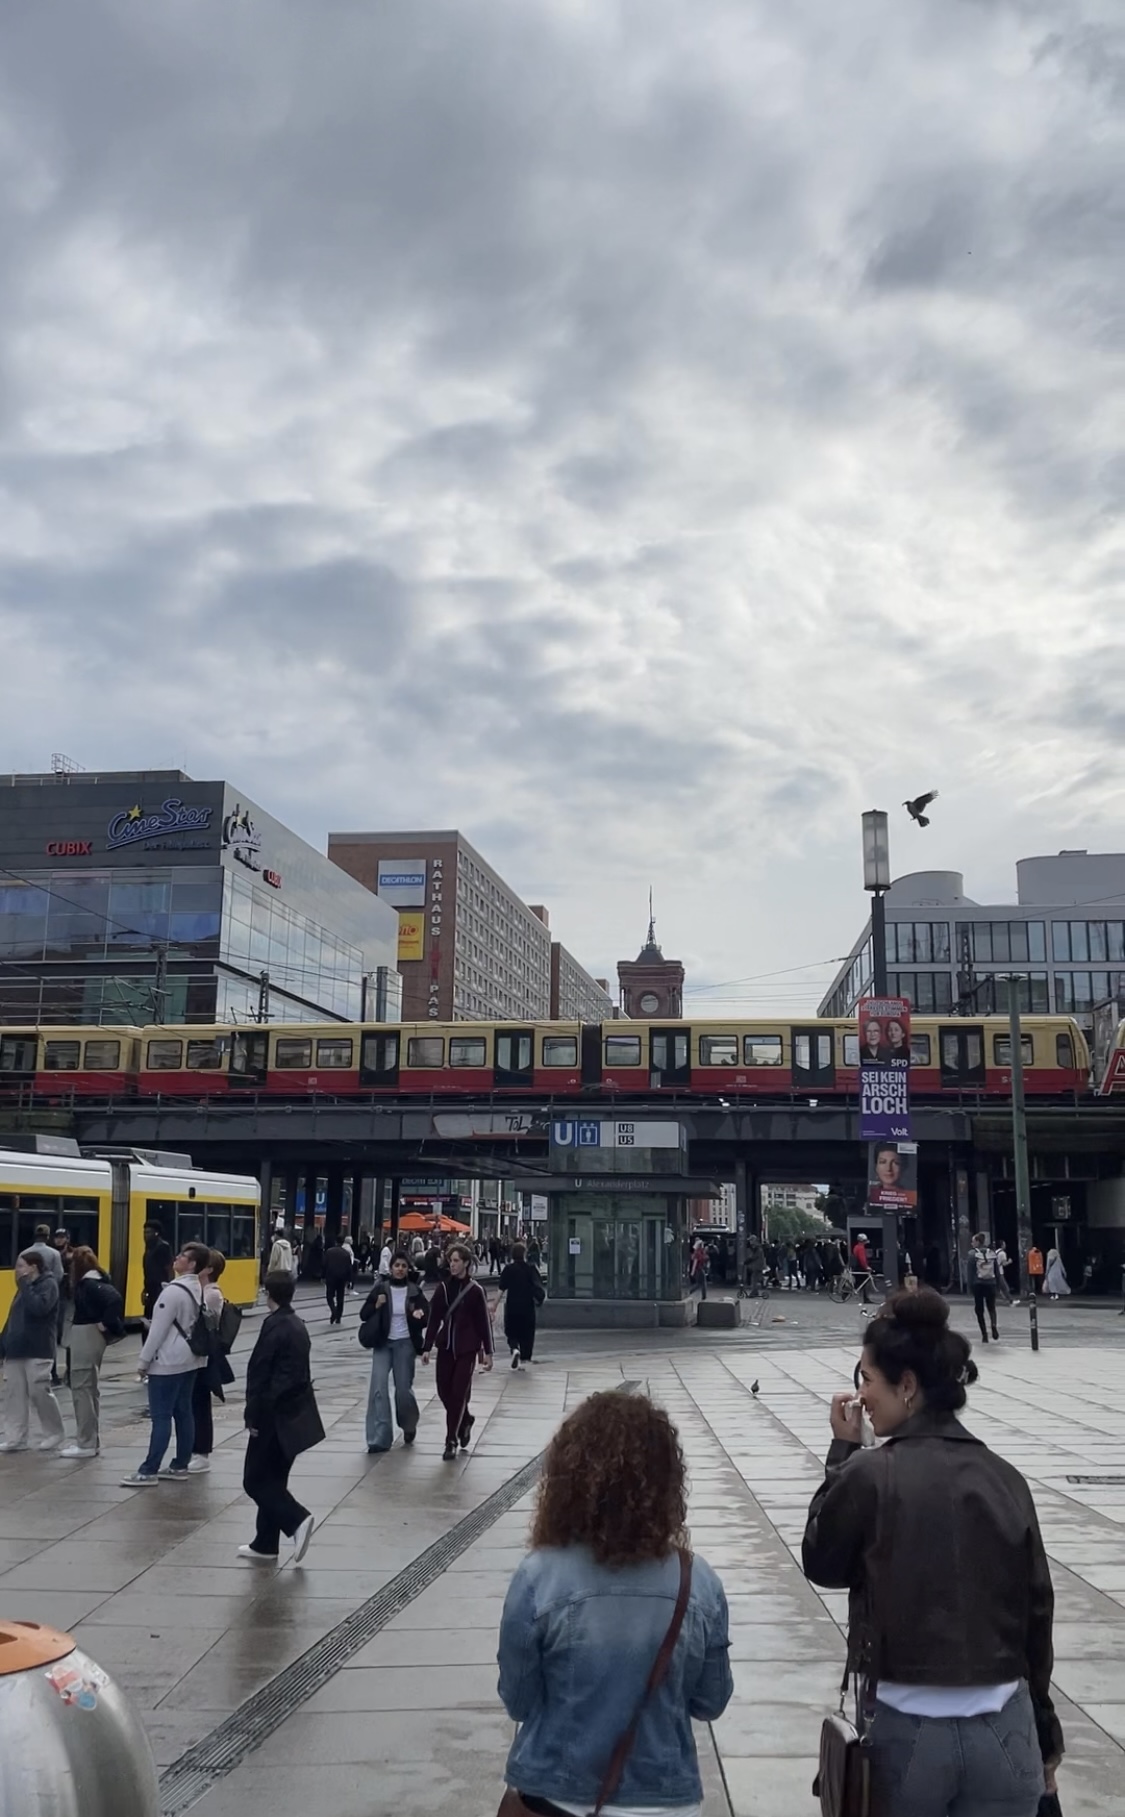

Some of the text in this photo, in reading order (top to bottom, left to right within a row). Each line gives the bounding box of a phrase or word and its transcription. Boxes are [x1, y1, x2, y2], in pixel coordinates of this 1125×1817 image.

[107, 798, 212, 843] CineStar
[46, 841, 93, 856] CUBIX
[381, 876, 423, 884] DECATHLON
[431, 859, 443, 936] RATHAUS
[890, 1058, 908, 1067] SPD
[861, 1071, 907, 1083] SEI KEIN
[862, 1083, 907, 1097] ARSCH
[862, 1097, 908, 1114] LOCH
[554, 1122, 573, 1146] U
[619, 1124, 634, 1133] U8
[891, 1127, 909, 1136] Volt
[619, 1136, 634, 1145] U5
[575, 1179, 650, 1191] U Alexanderplatz
[315, 1192, 325, 1205] U
